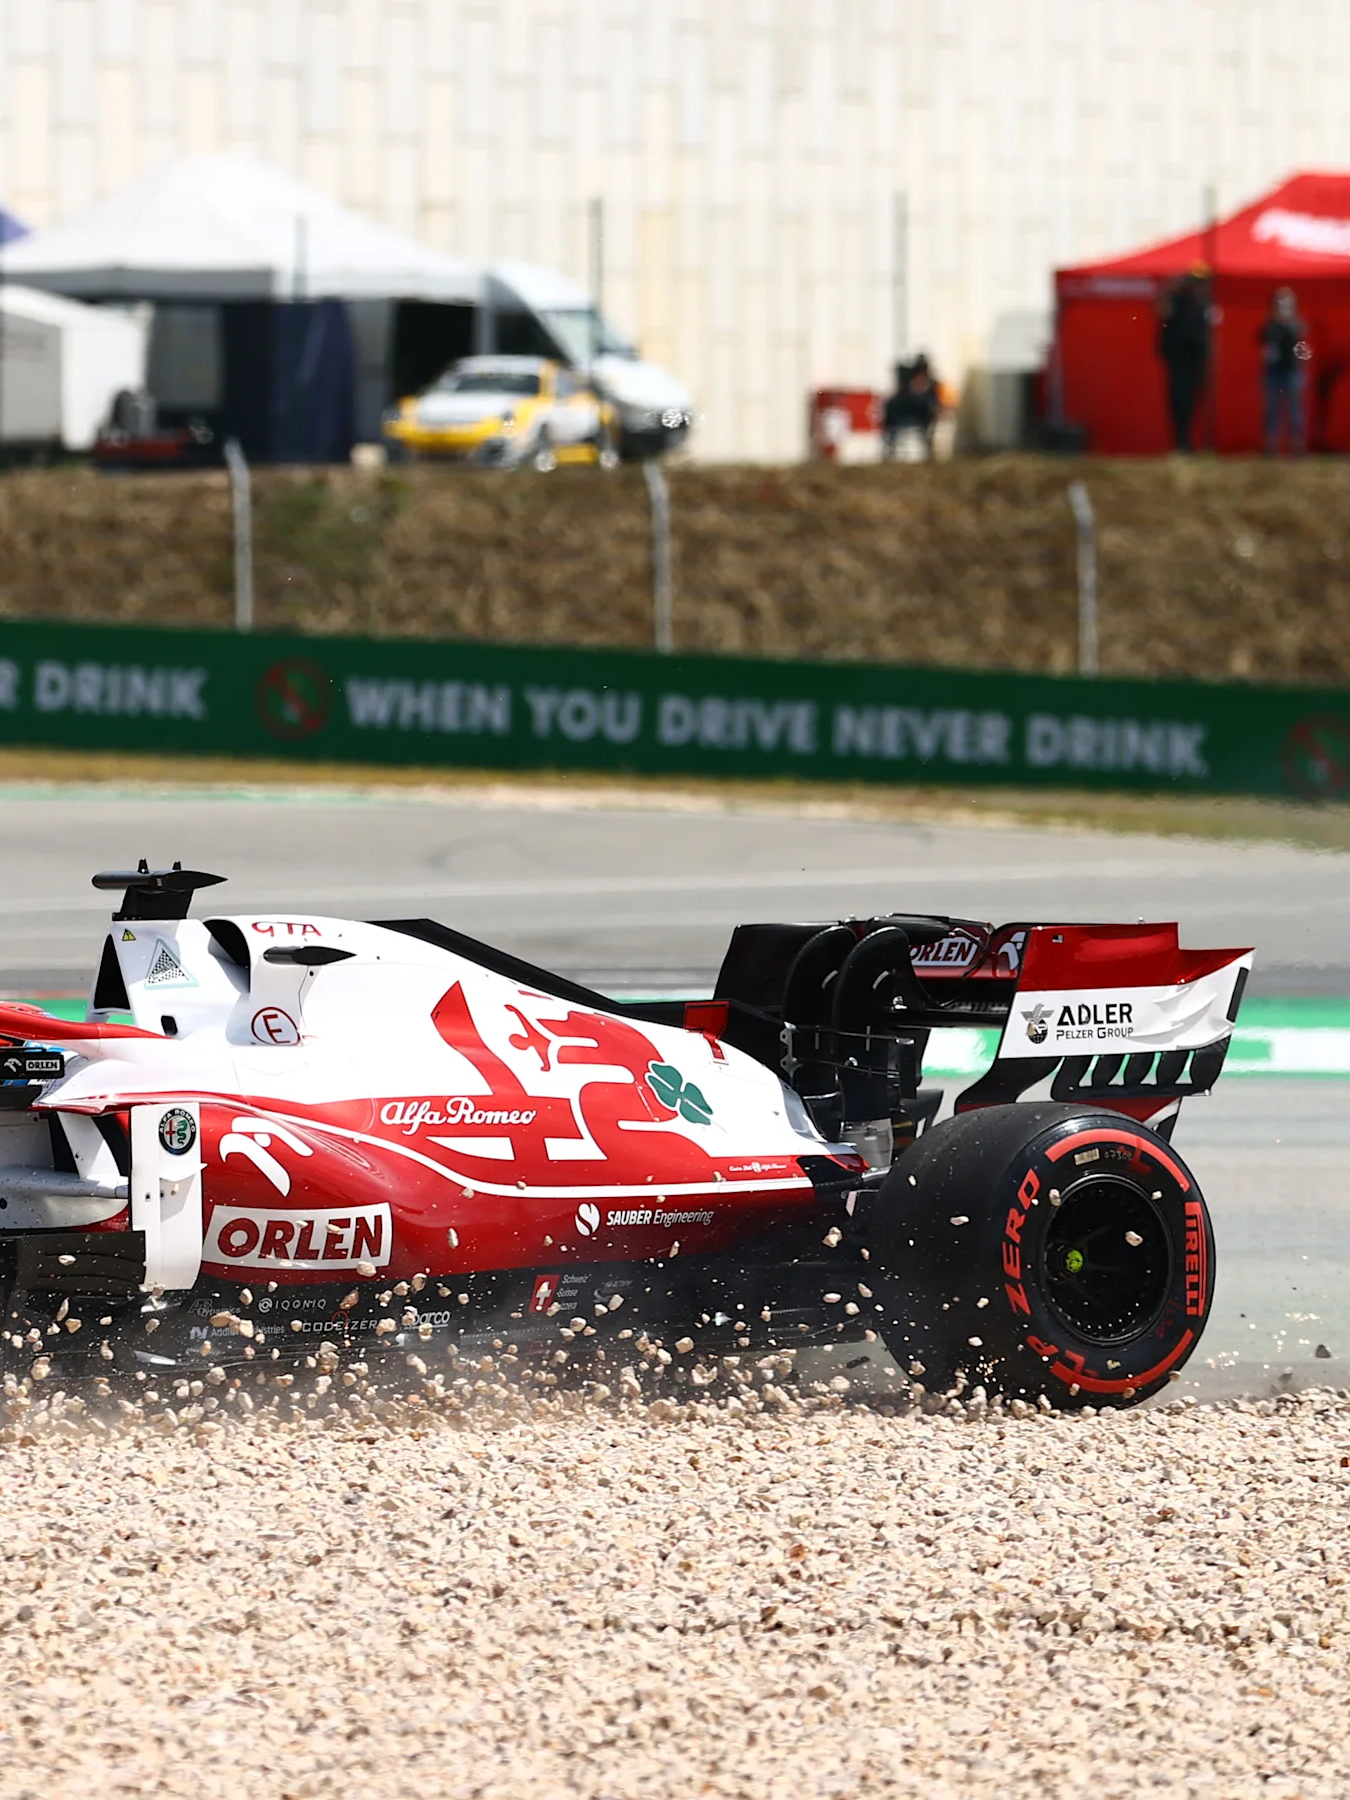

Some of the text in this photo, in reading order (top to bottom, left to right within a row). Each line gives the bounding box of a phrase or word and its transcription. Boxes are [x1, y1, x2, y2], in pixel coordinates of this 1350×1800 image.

[35, 659, 208, 720] DRINK
[345, 675, 1208, 777] WHEN YOU DRIVE NEVER DRINK
[251, 921, 322, 937] GTA
[1057, 1003, 1133, 1026] ADLER
[380, 1097, 537, 1135] Alfa Romeo
[606, 1209, 714, 1228] SAUBER Engineering
[217, 1215, 382, 1260] ORLEN
[1002, 1168, 1040, 1315] ZERO
[1184, 1201, 1207, 1317] PIRELLI
[275, 1299, 326, 1311] IQONIQ
[350, 1319, 378, 1331] ZER
[414, 1311, 451, 1330] parco
